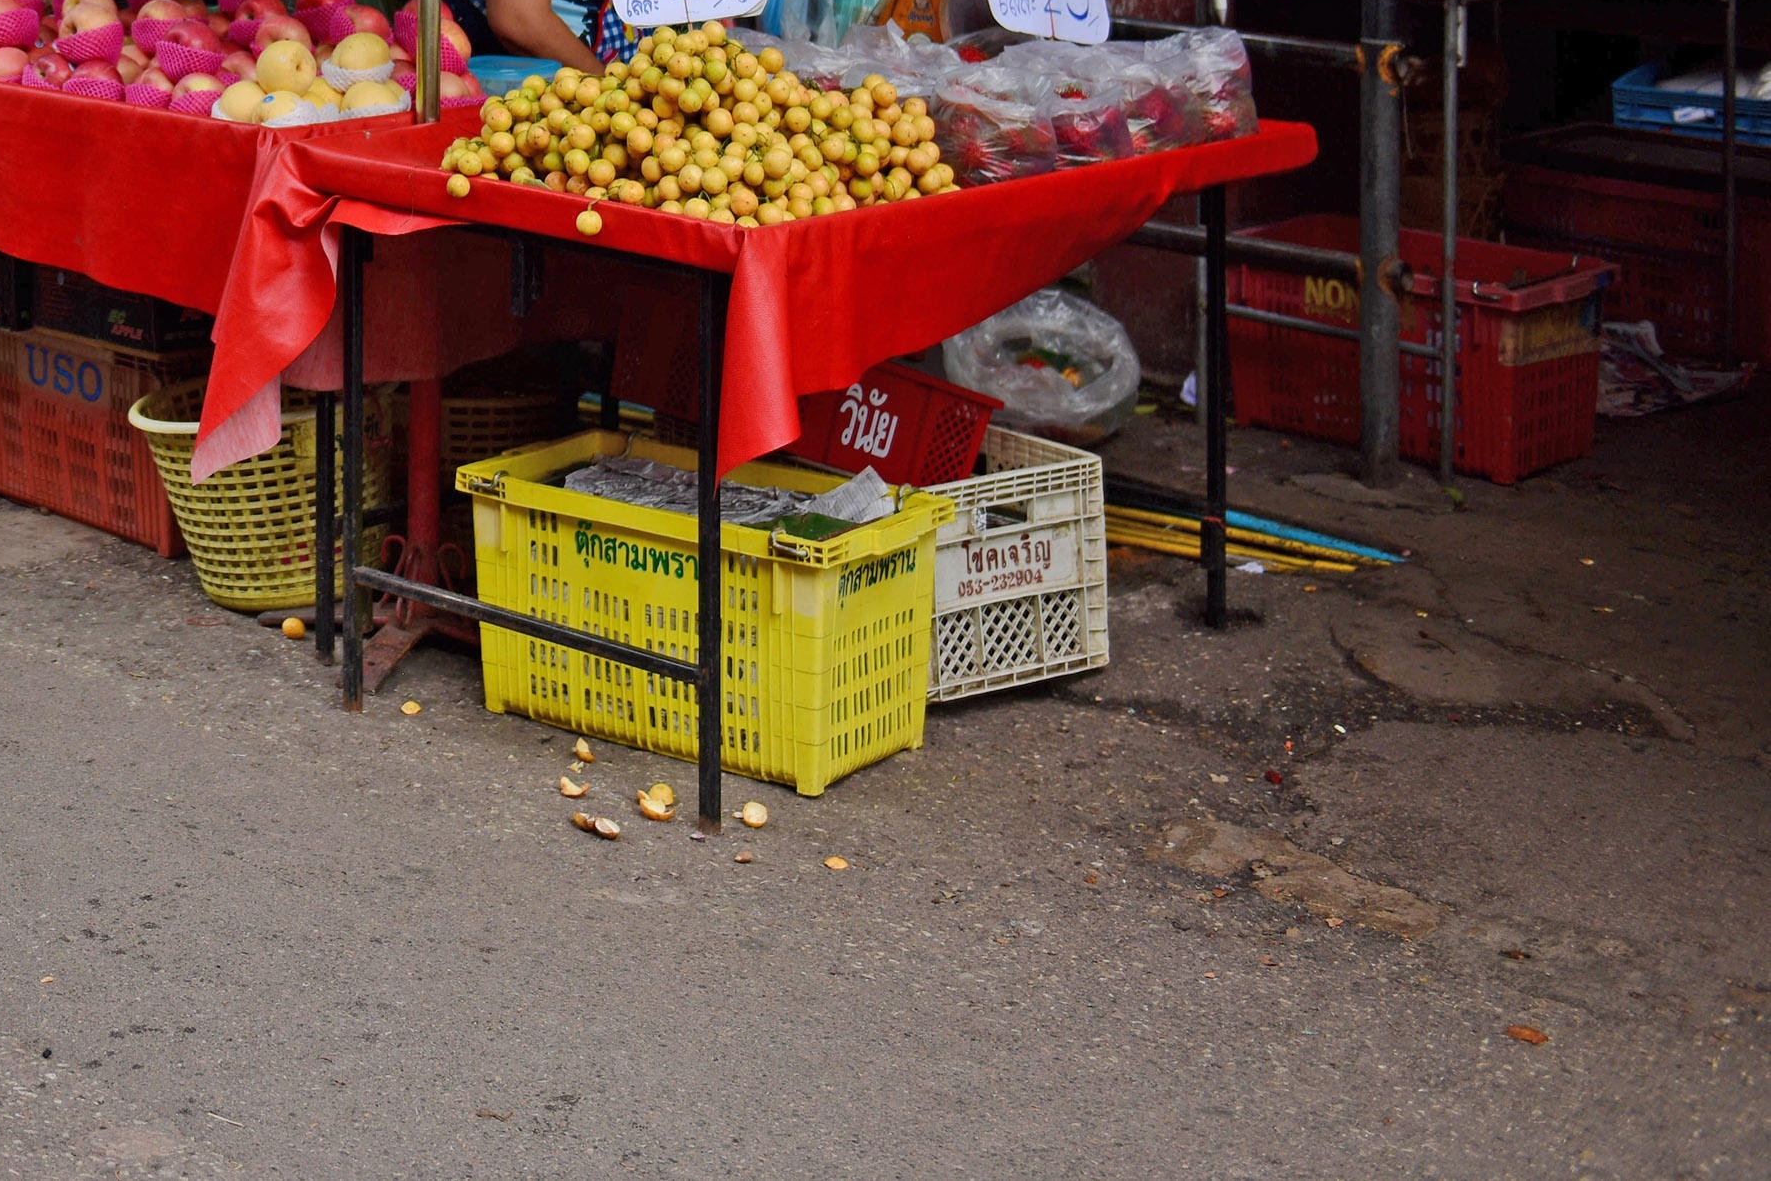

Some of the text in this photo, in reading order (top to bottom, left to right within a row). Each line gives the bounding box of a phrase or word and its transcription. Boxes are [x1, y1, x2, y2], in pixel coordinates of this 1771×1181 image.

[111, 323, 144, 340] APPLE
[25, 343, 104, 402] USO
[840, 382, 899, 459] วินัย
[961, 533, 1052, 575] โชคเจริญ
[957, 566, 1044, 598] 053-232904
